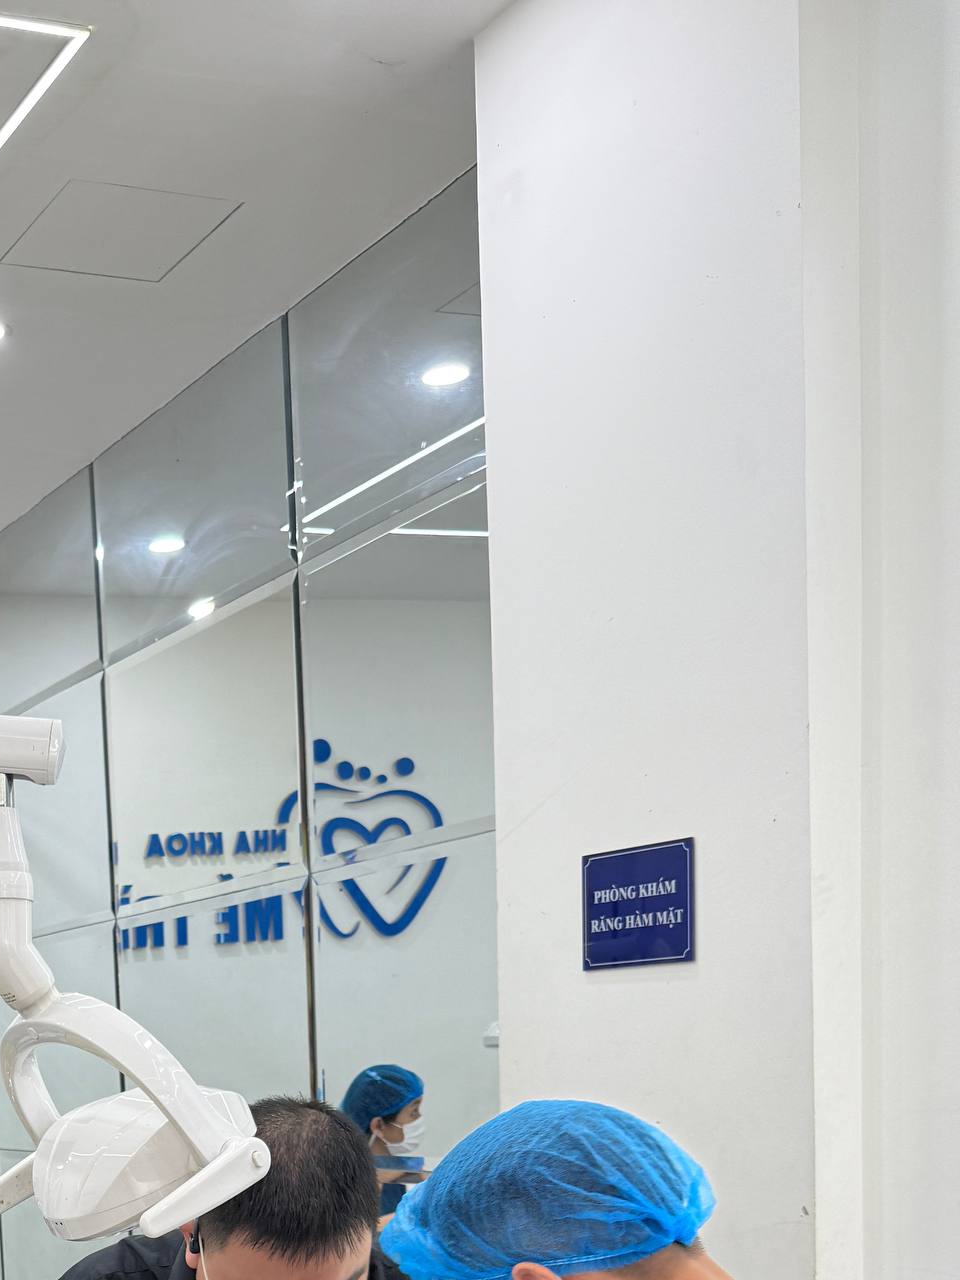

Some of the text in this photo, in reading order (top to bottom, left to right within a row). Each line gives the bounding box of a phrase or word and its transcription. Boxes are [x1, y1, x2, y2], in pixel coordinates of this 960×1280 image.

[593, 877, 677, 904] PHÒNG KHÁM
[590, 907, 684, 933] RĂNG HÀM MẶT
